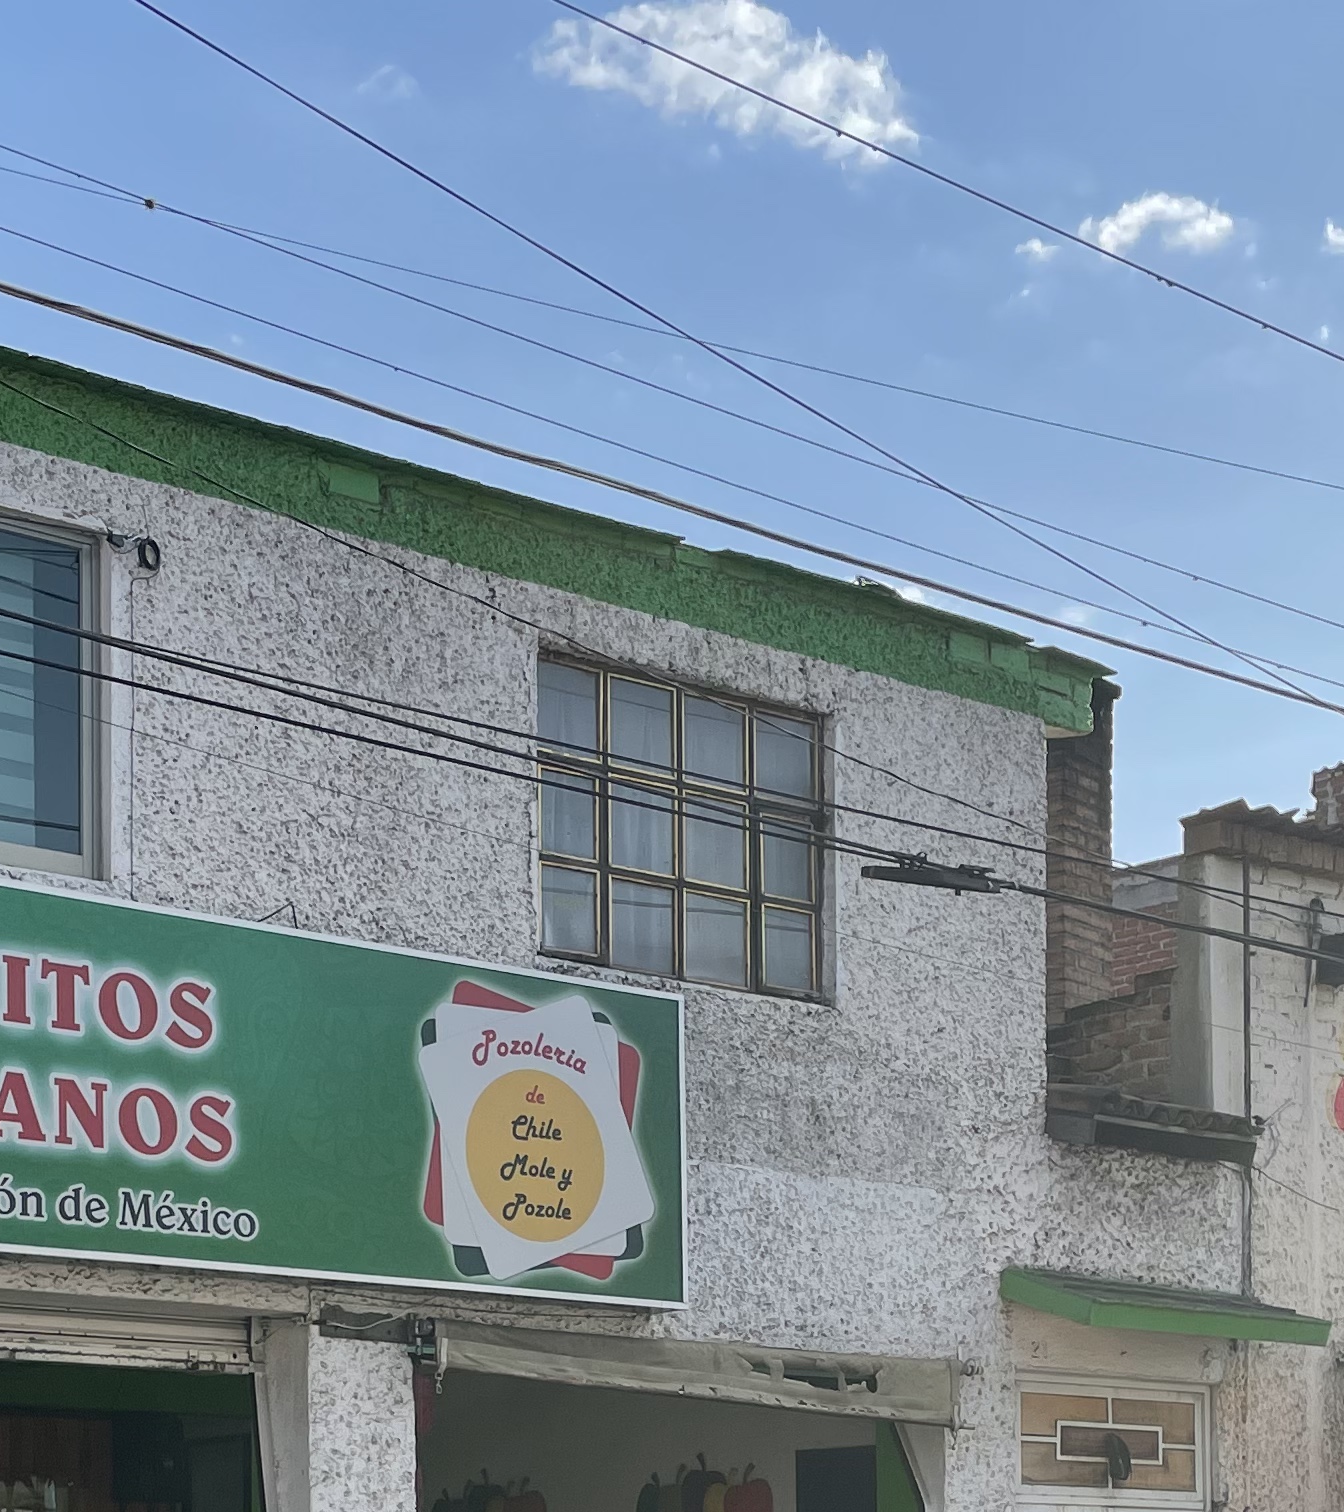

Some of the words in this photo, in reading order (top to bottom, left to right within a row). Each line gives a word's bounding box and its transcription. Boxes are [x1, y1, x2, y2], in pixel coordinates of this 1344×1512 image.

[471, 1028, 587, 1075] Pozoleria
[525, 1085, 546, 1105] de
[511, 1114, 563, 1141] Chile
[500, 1153, 556, 1182] Mole
[557, 1167, 573, 1192] y
[58, 1183, 106, 1224] de
[119, 1190, 260, 1240] México
[502, 1193, 572, 1221] Pozole
